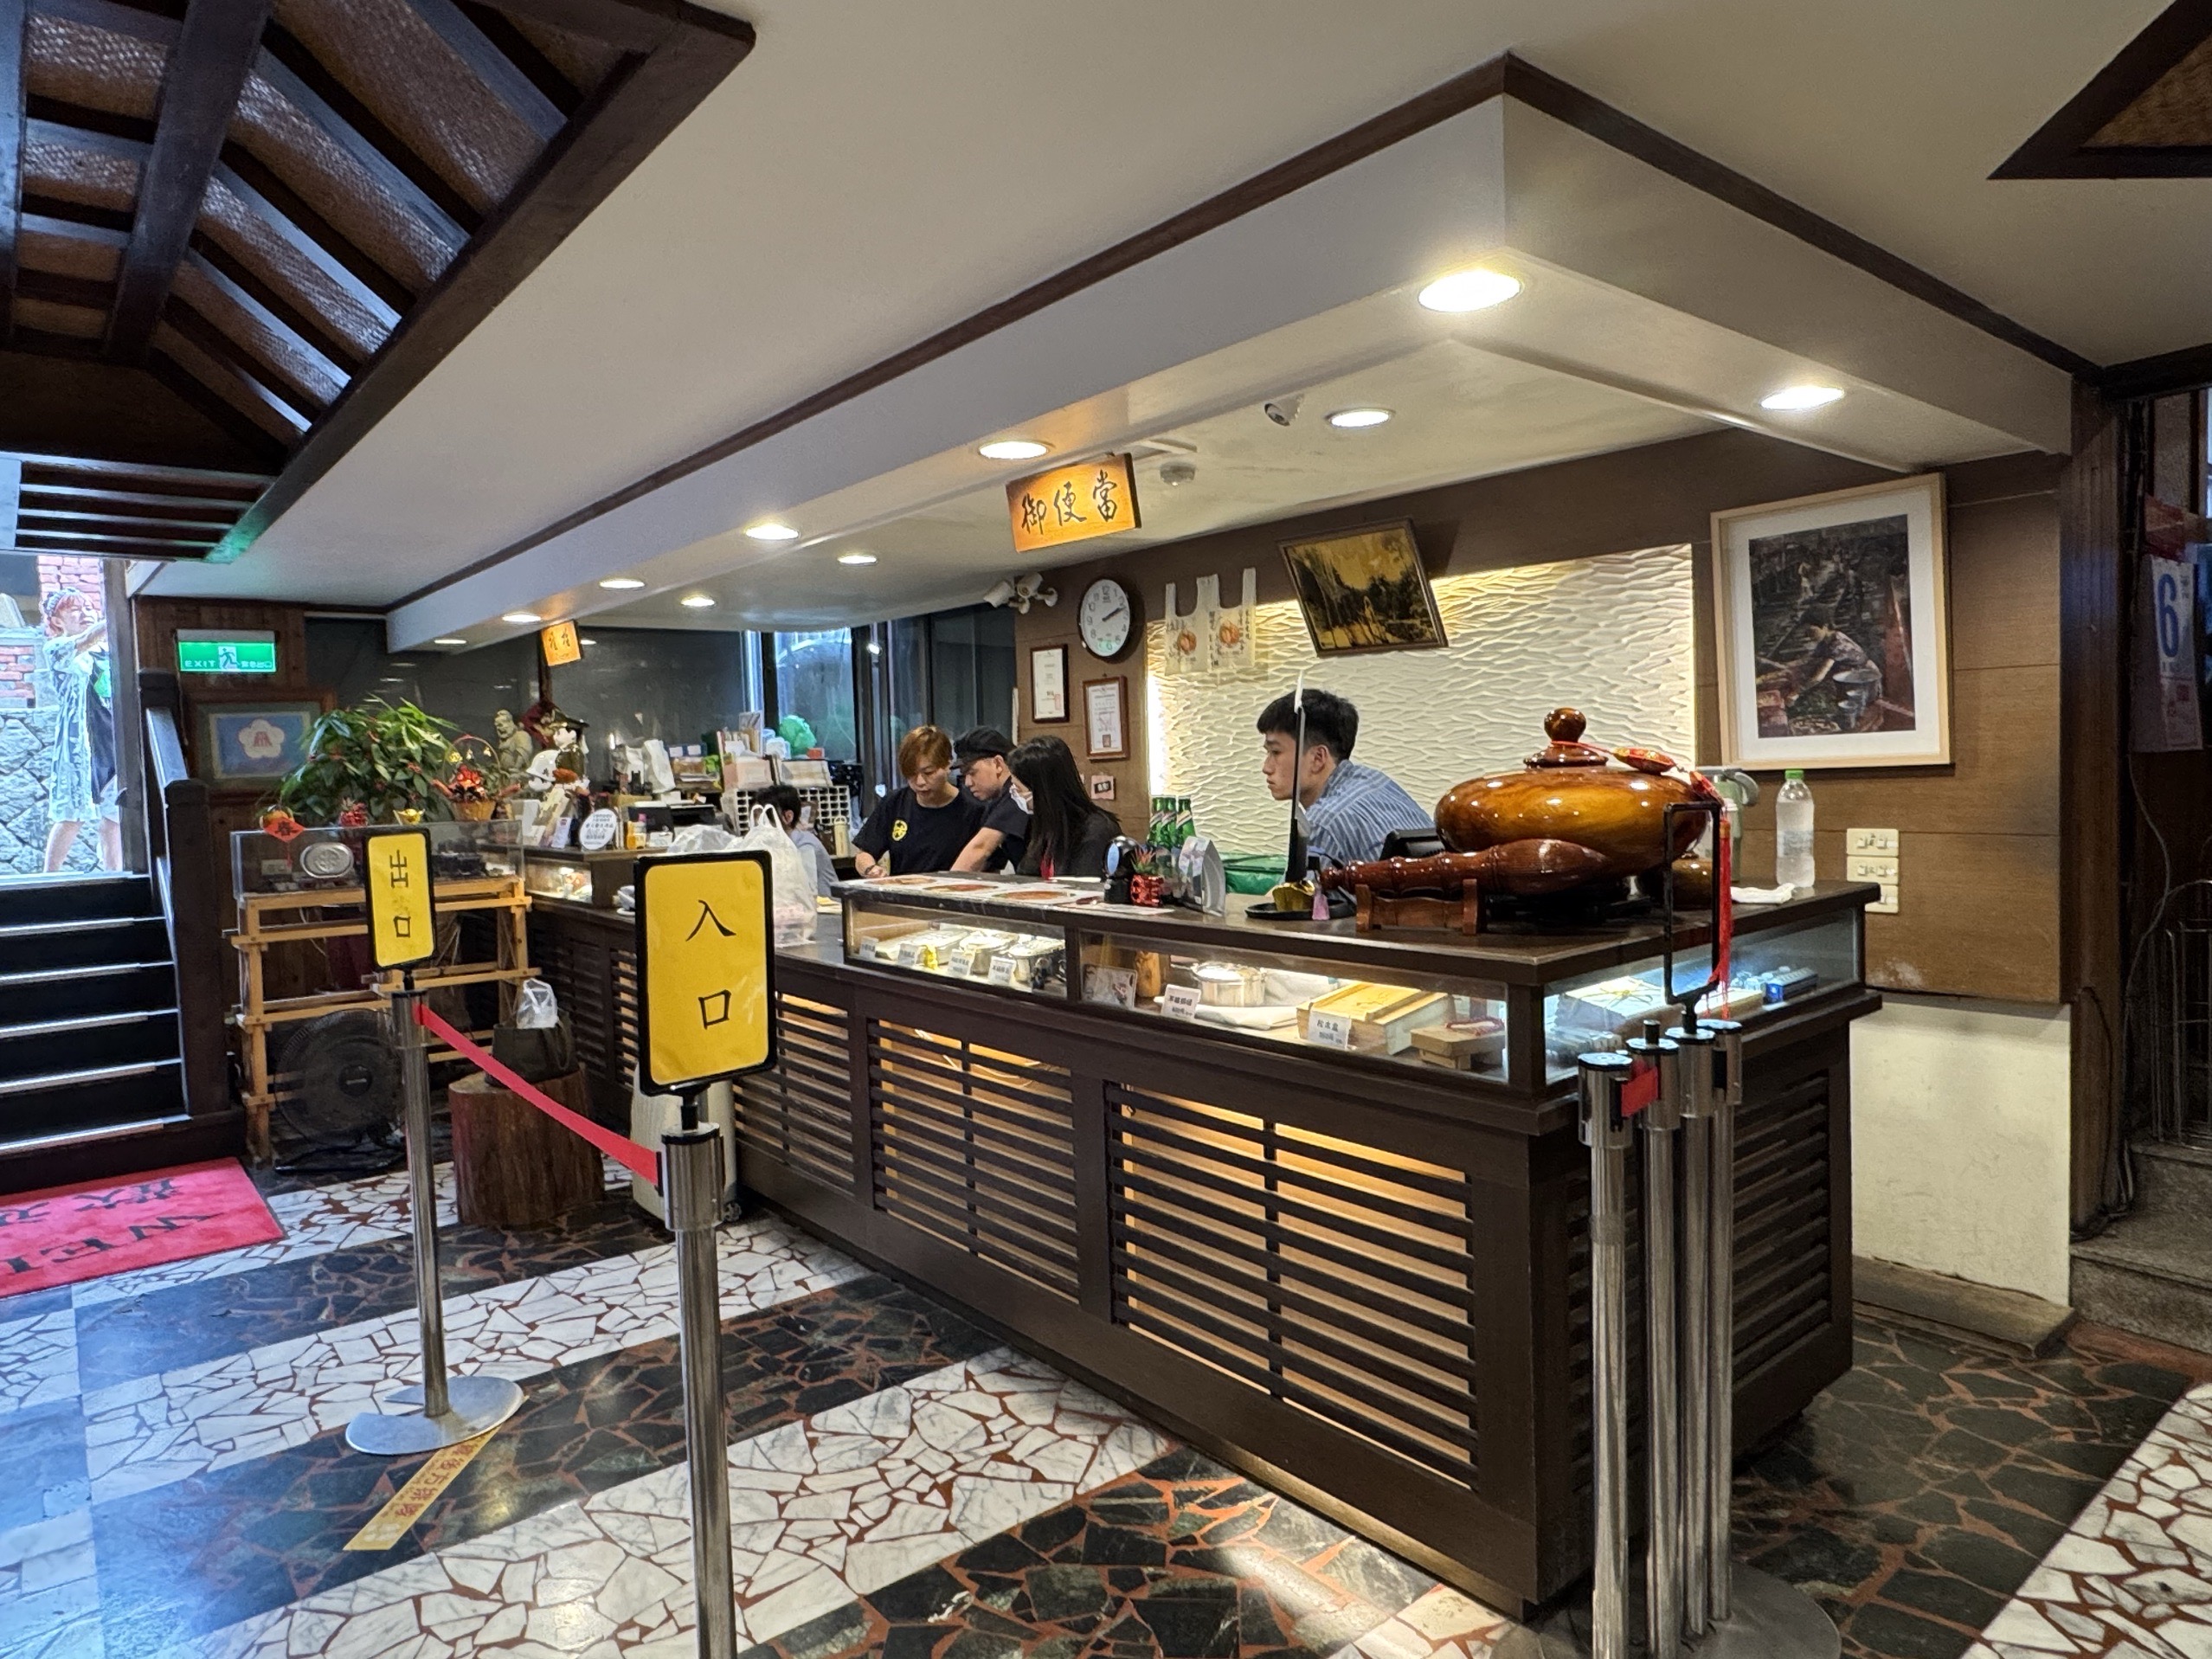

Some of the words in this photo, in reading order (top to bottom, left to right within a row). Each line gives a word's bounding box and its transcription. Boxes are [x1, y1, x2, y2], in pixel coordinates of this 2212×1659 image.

[1021, 469, 1117, 535] 御便當
[2158, 574, 2178, 658] 6
[389, 849, 411, 938] 出口
[685, 900, 736, 1030] 入口
